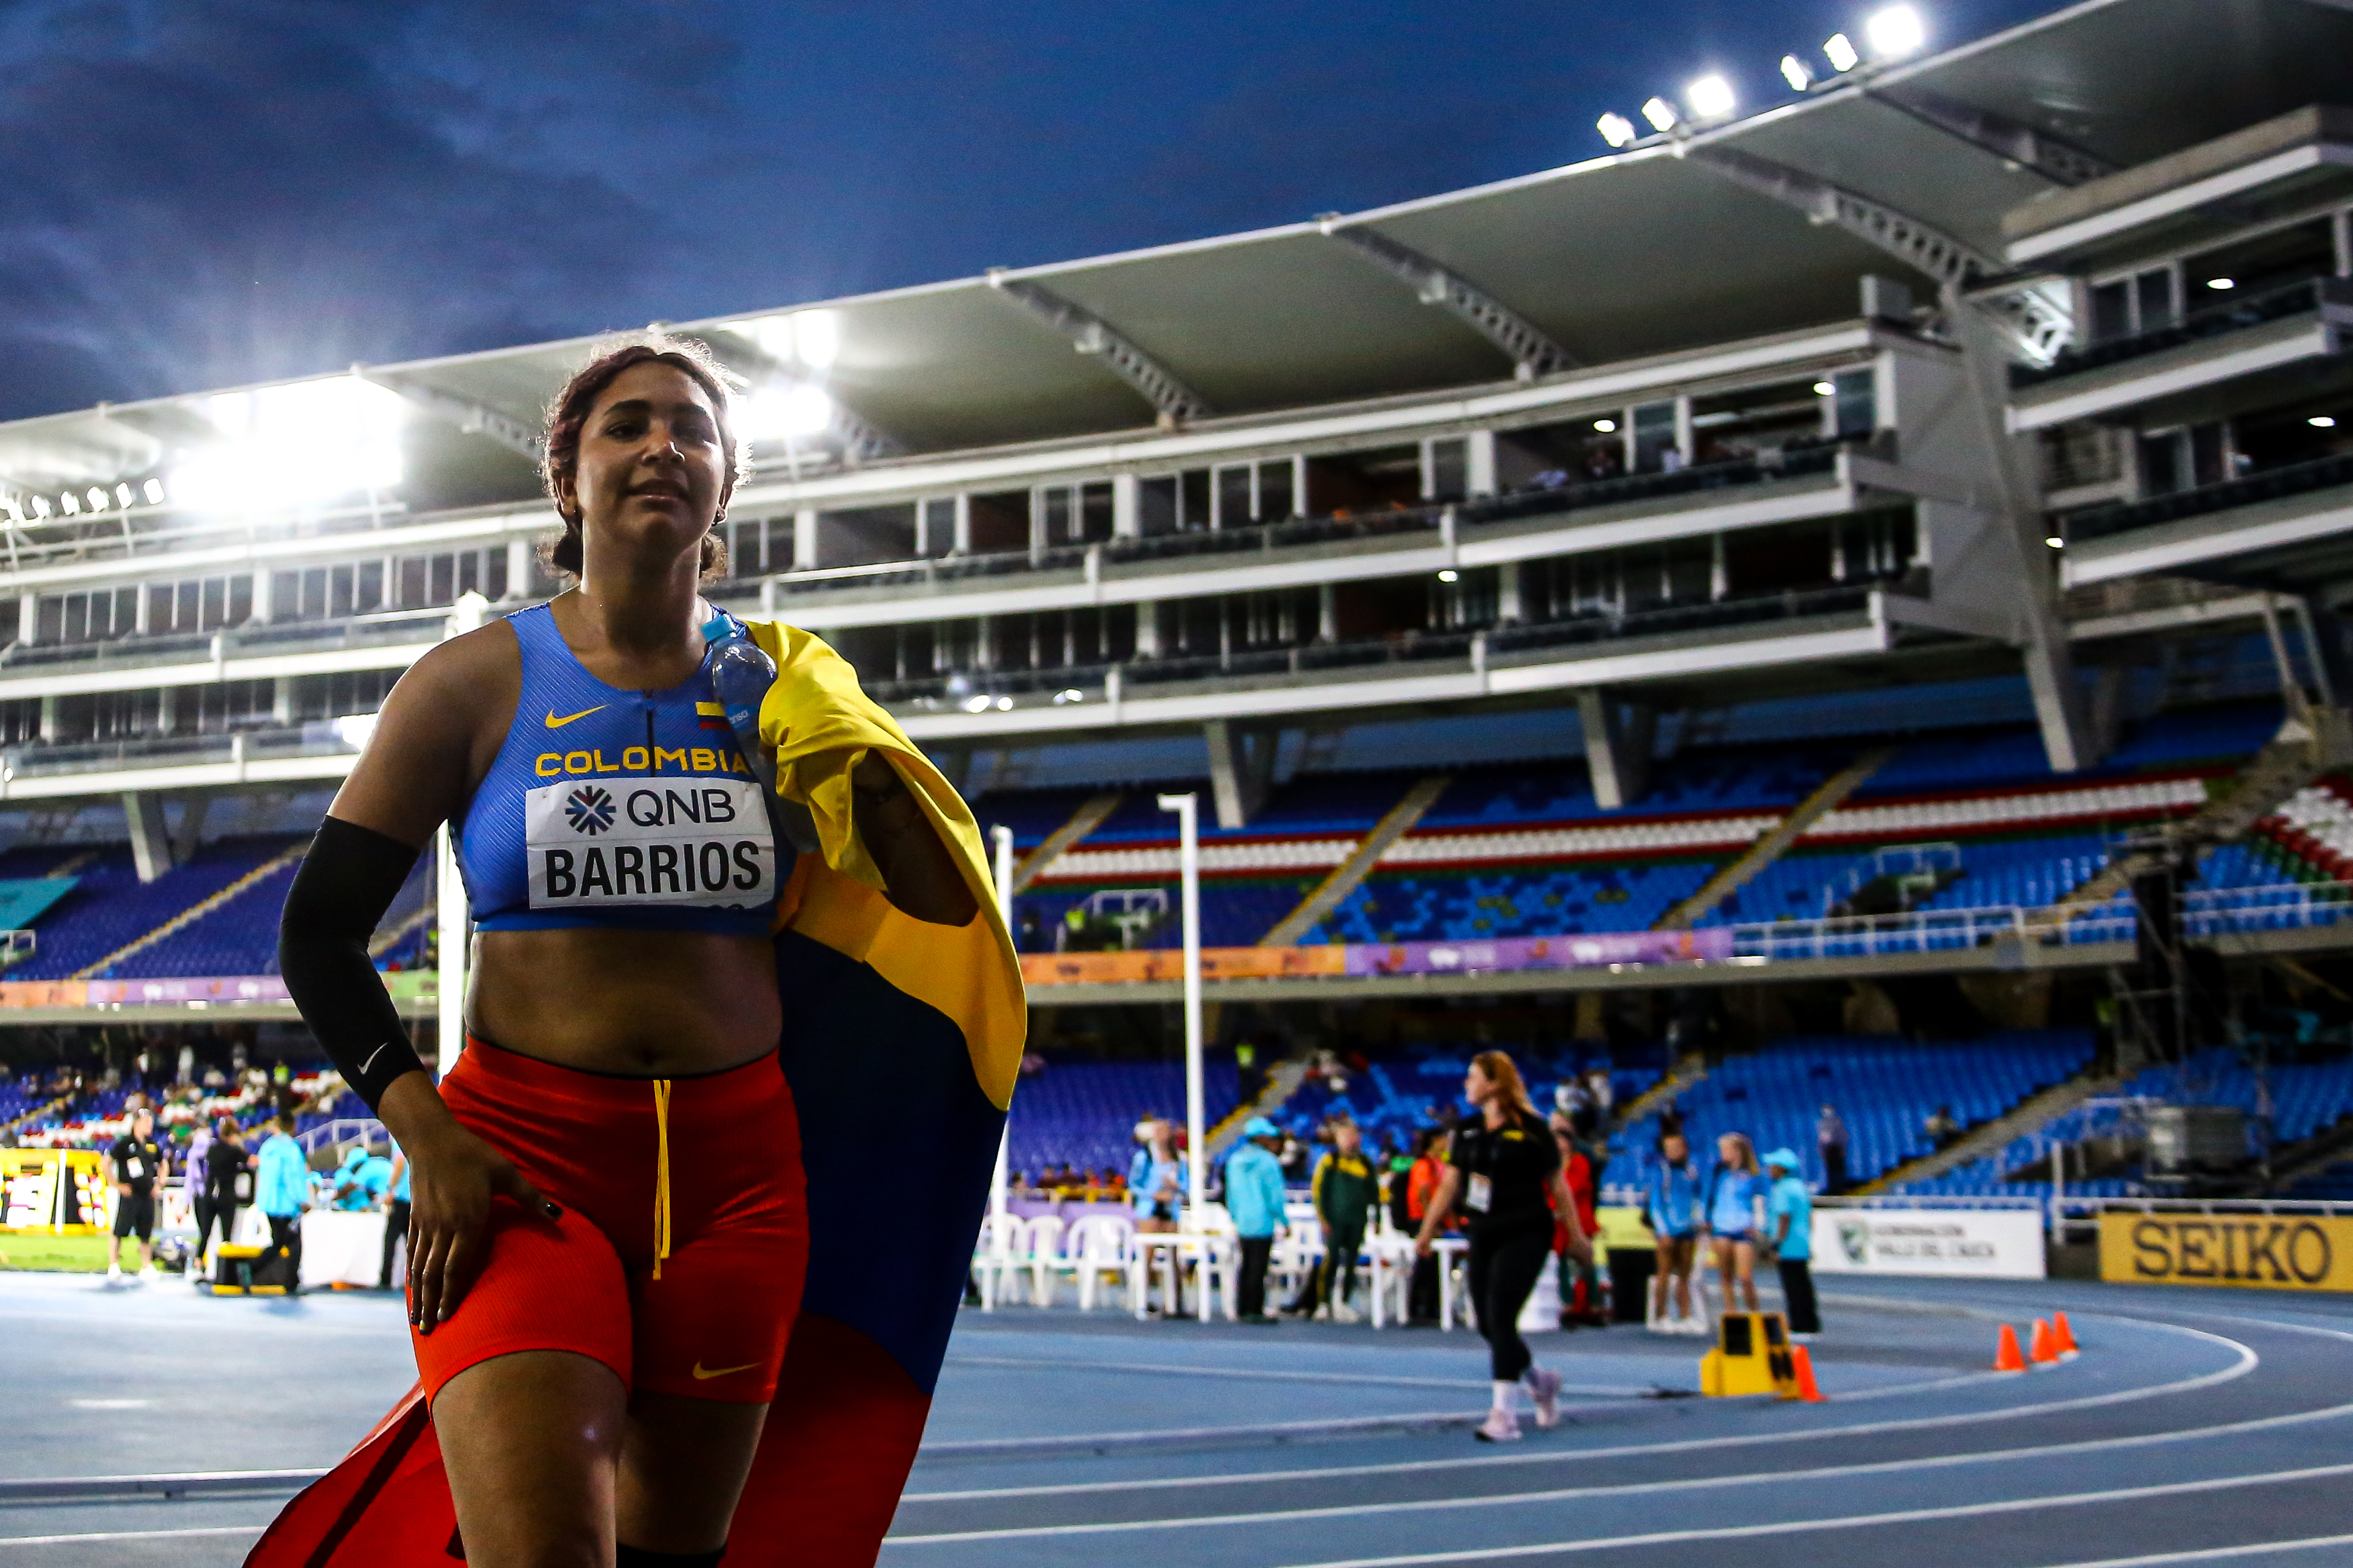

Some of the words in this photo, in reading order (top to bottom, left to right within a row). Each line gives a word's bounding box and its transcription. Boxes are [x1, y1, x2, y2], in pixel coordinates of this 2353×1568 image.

[536, 746, 749, 777] COLOMBIA
[626, 788, 736, 827] QNB
[545, 840, 761, 898] BARRIOS
[2132, 1220, 2333, 1283] SEIKO
